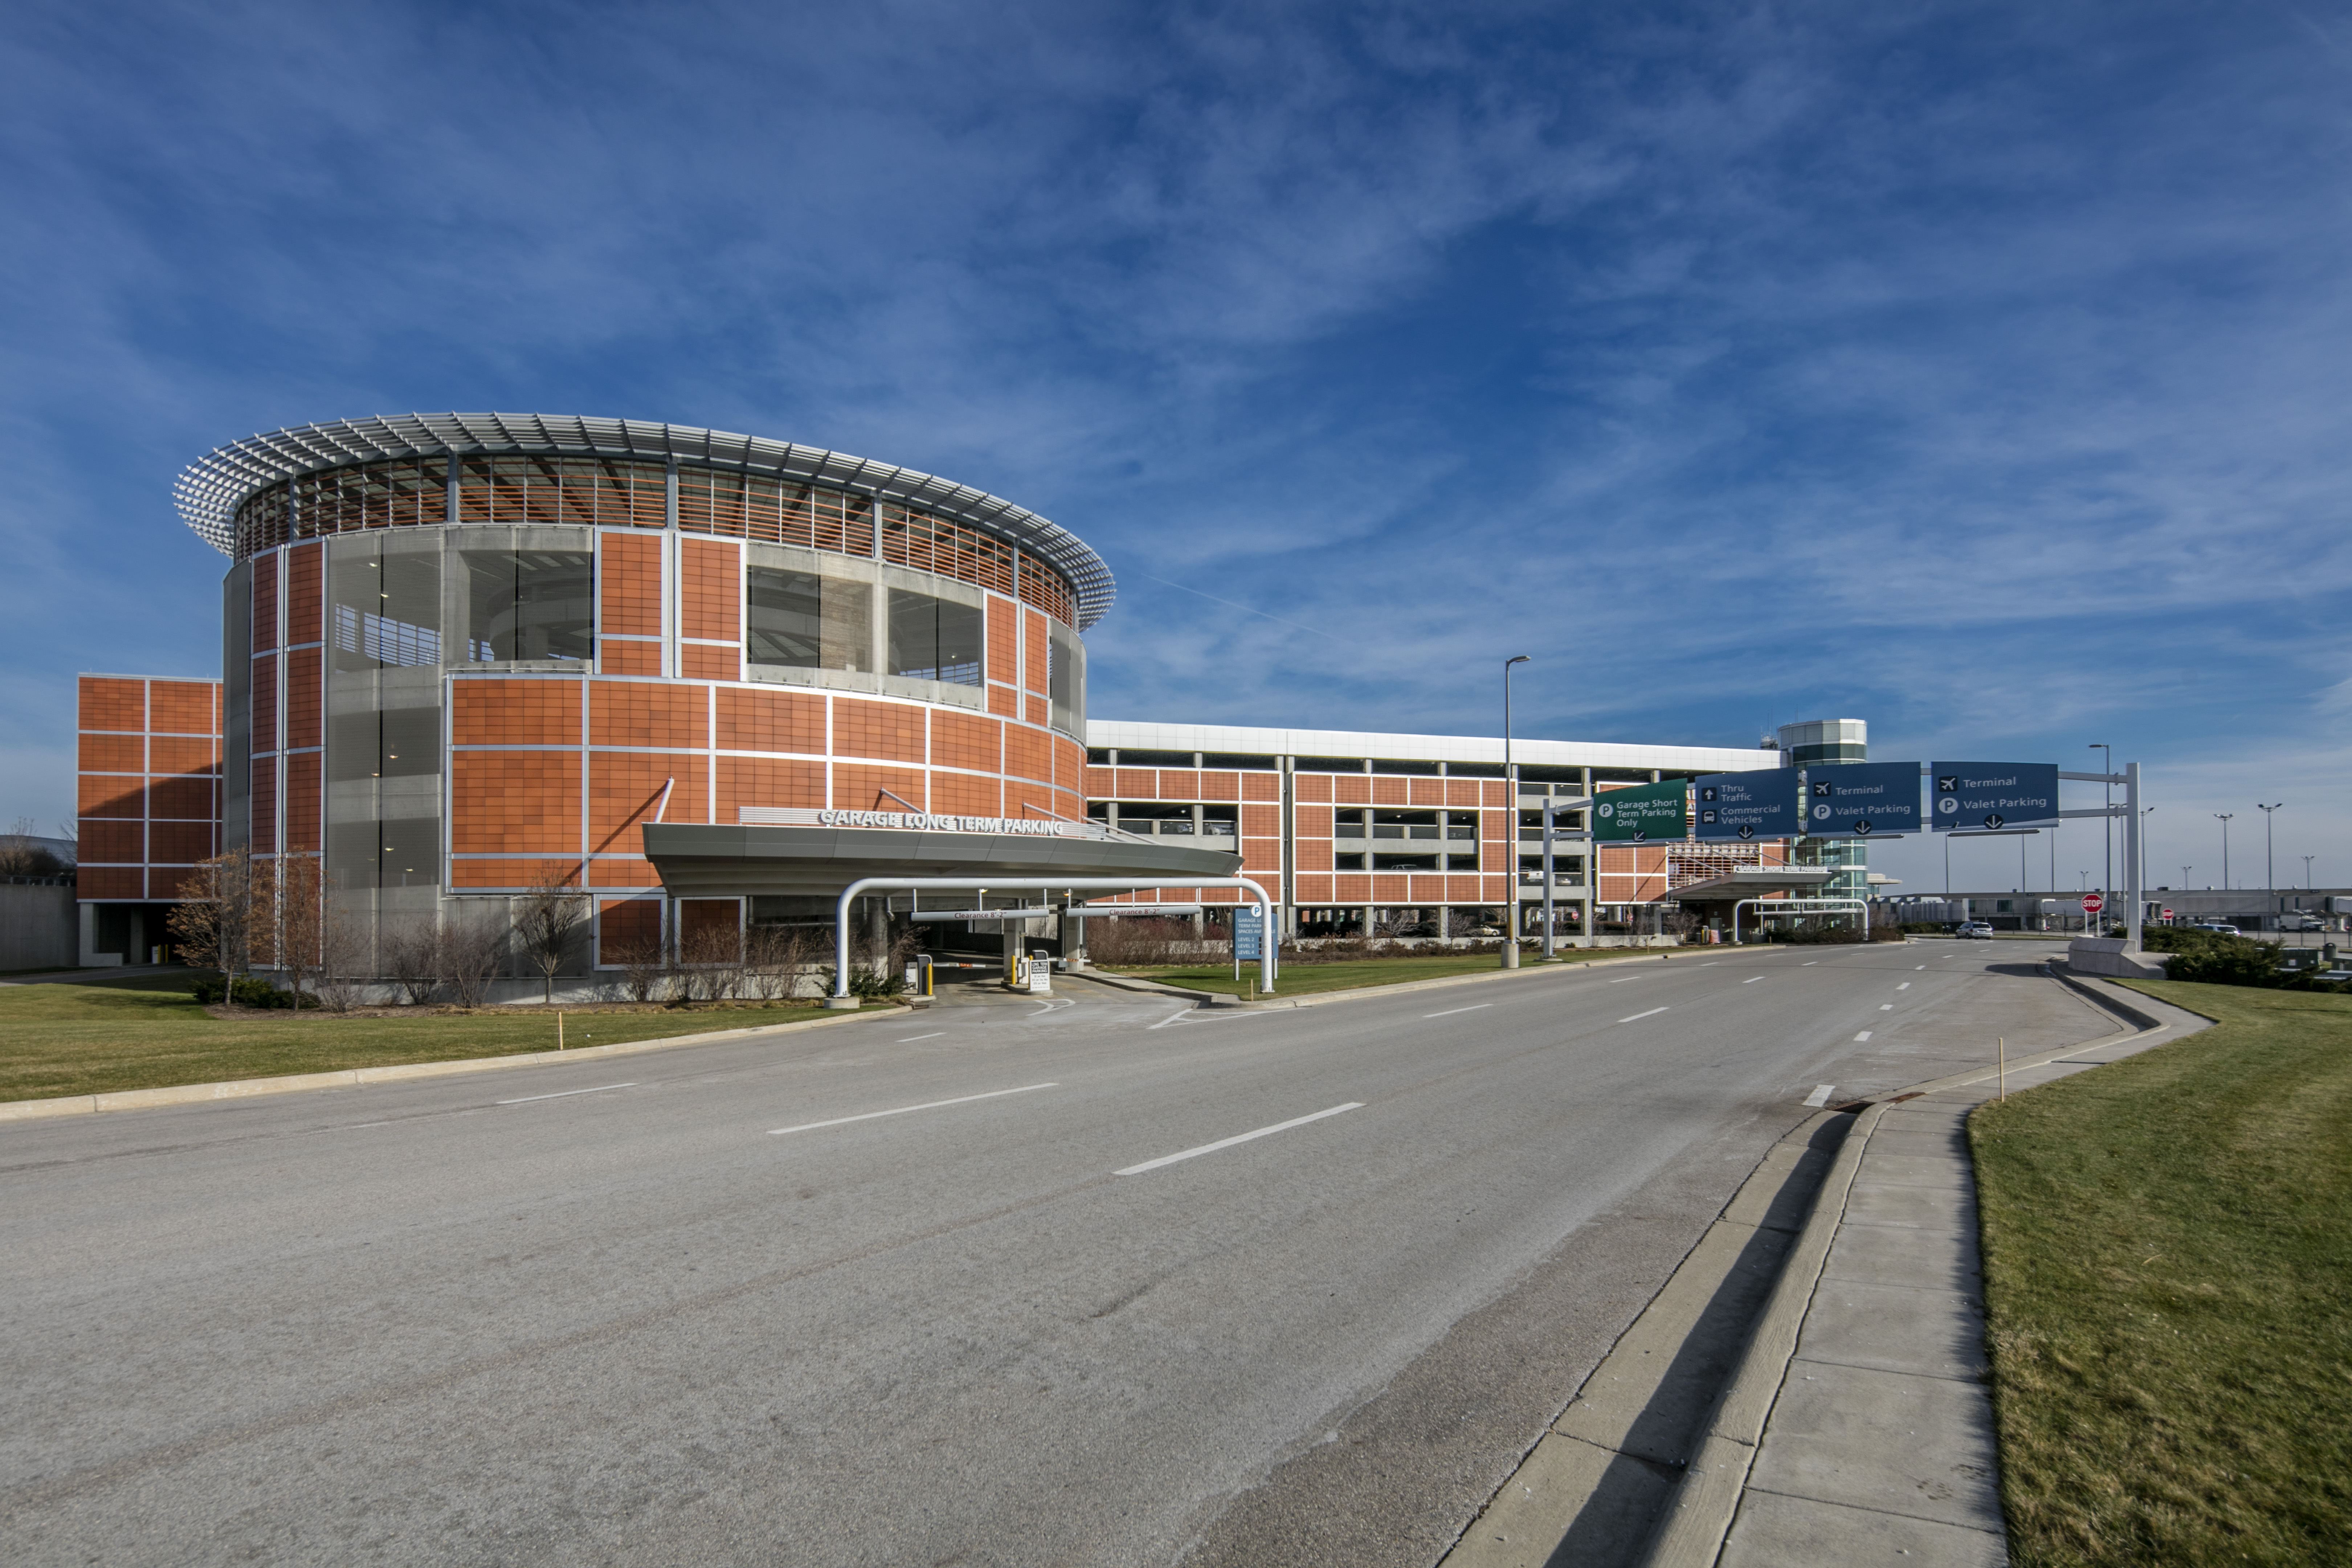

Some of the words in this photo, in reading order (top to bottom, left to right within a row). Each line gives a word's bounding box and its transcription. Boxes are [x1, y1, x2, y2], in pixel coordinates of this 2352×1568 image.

[1963, 777, 2016, 787] Terminal
[1836, 785, 1883, 795] Terminal
[1721, 793, 1751, 801] Traffic
[1964, 800, 1995, 809] Valet
[2000, 798, 2046, 807] Parking
[1721, 805, 1780, 814] Commercial
[1868, 805, 1910, 814] Parking
[820, 810, 898, 826] GARAGE
[904, 813, 950, 829] LONG
[955, 816, 999, 831] TERM
[1004, 818, 1063, 834] PARKING
[1617, 819, 1637, 828] Only
[1722, 816, 1762, 824] Vehicles
